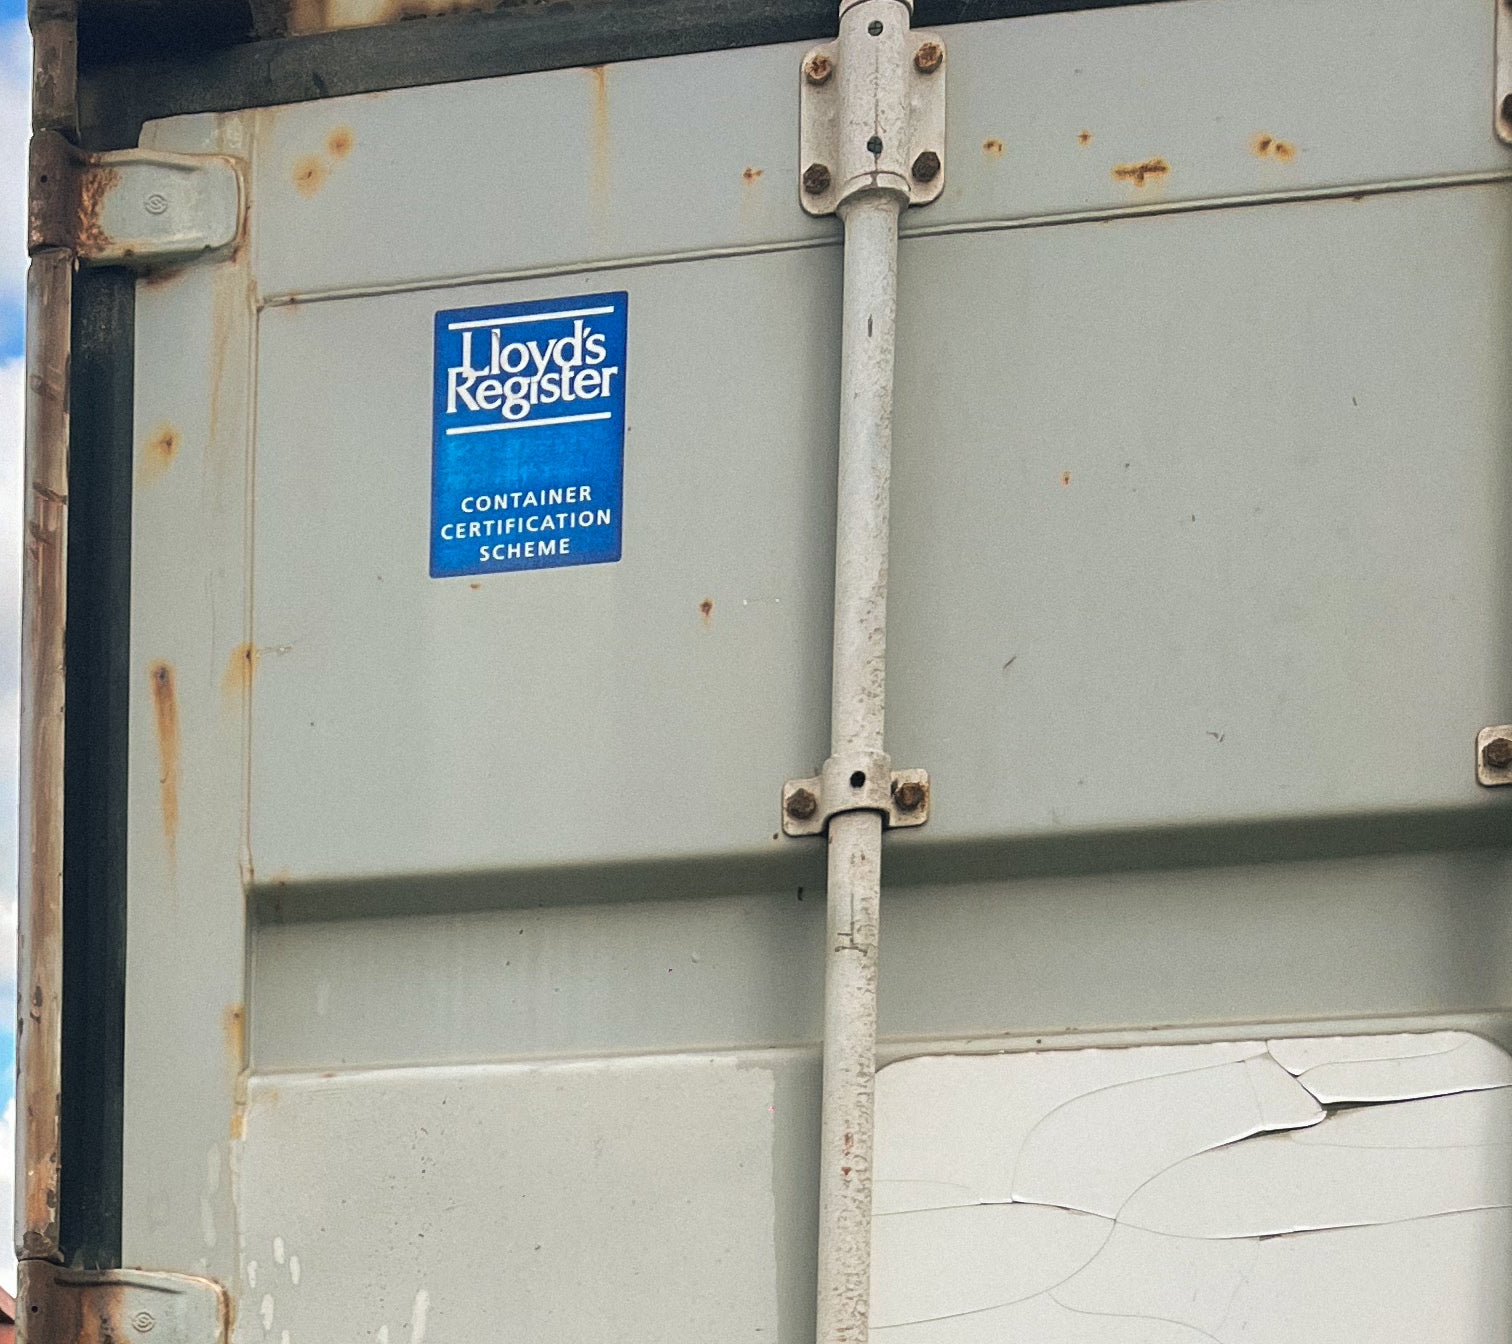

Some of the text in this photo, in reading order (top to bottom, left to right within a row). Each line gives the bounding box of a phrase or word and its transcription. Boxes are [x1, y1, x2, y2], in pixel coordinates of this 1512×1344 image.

[462, 319, 607, 379] Lloyd's
[446, 362, 618, 420] Register
[461, 486, 592, 513] CONTAINER
[440, 509, 612, 540] CERTIFICATION
[479, 538, 571, 562] SCHEME
